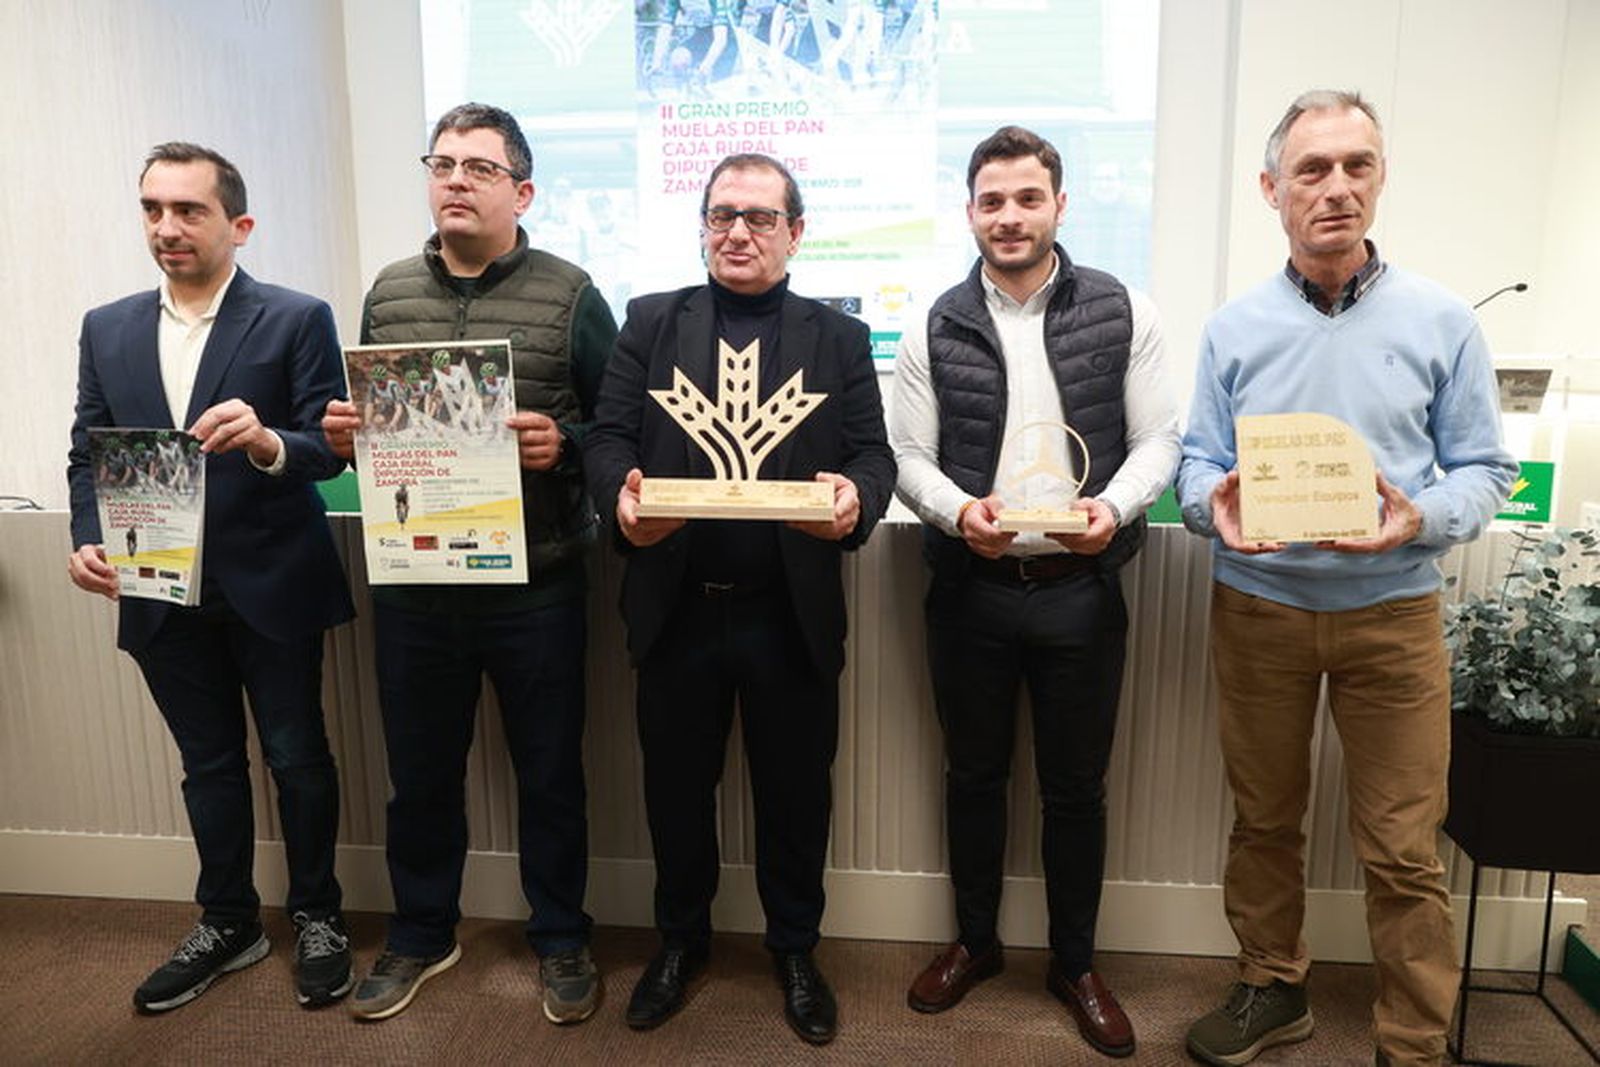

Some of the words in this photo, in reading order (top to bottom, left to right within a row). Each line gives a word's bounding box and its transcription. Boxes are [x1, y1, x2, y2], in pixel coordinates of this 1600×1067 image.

[661, 105, 673, 120] II
[678, 103, 731, 119] GRAN
[735, 101, 810, 118] PREMIO
[662, 121, 738, 138] MUELAS
[743, 120, 779, 136] DEL
[785, 119, 825, 135] PAN
[662, 141, 711, 157] CAJA
[716, 139, 778, 155] RURAL
[372, 450, 413, 459] MUELAS
[415, 450, 433, 458] DEL
[436, 449, 458, 458] PAN
[372, 460, 399, 469] CAJA
[401, 460, 434, 468] RURAL
[437, 468, 451, 477] DE
[375, 478, 418, 487] ZAMORA
